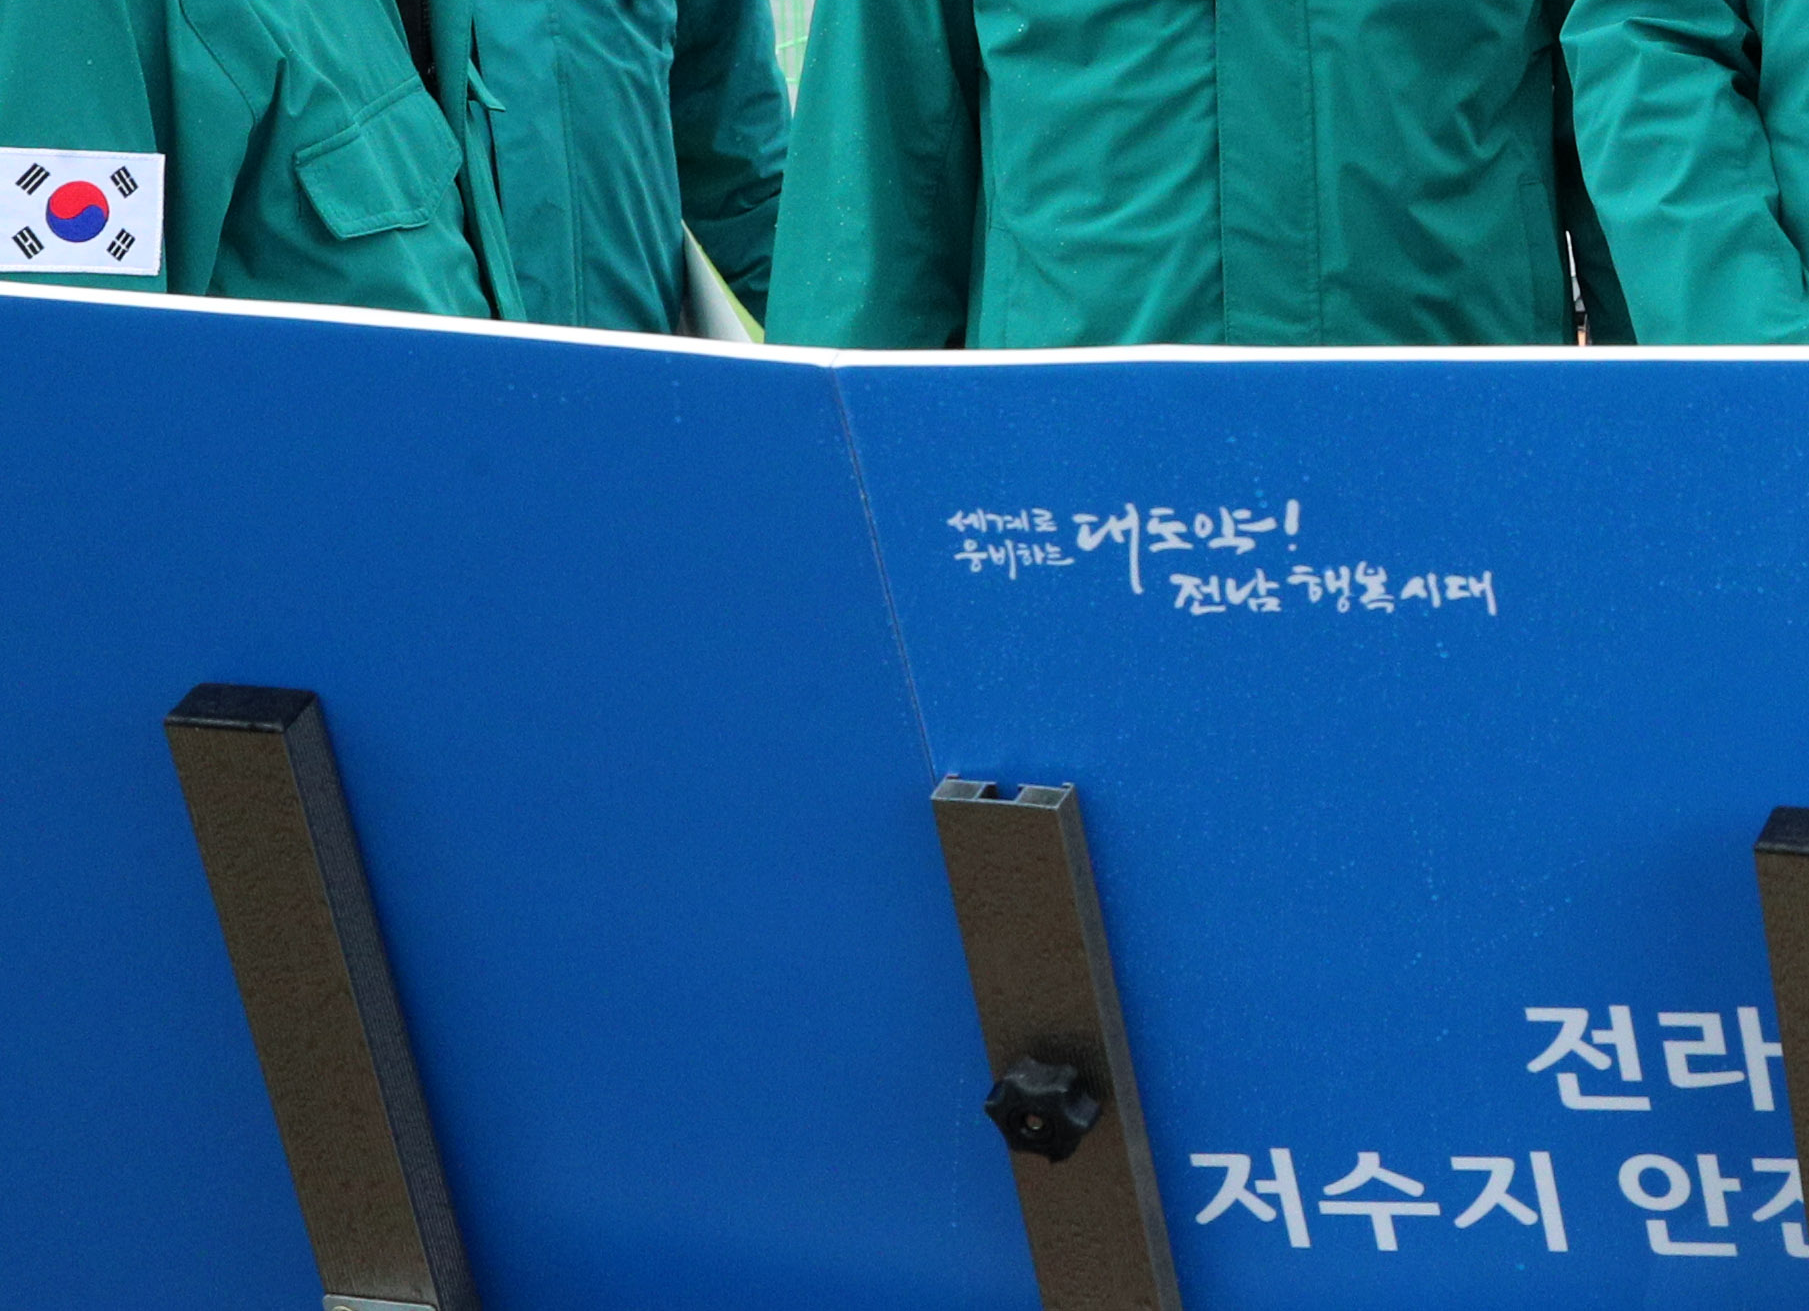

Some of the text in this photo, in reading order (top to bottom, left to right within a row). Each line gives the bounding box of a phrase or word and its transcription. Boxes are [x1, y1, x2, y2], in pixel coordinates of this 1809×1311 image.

[946, 507, 1058, 533] 세계로
[954, 539, 1075, 581] 웅비하는
[1072, 499, 1301, 594] 대도약!
[1169, 567, 1282, 616] 전남
[1190, 1146, 1569, 1253] 저수지
